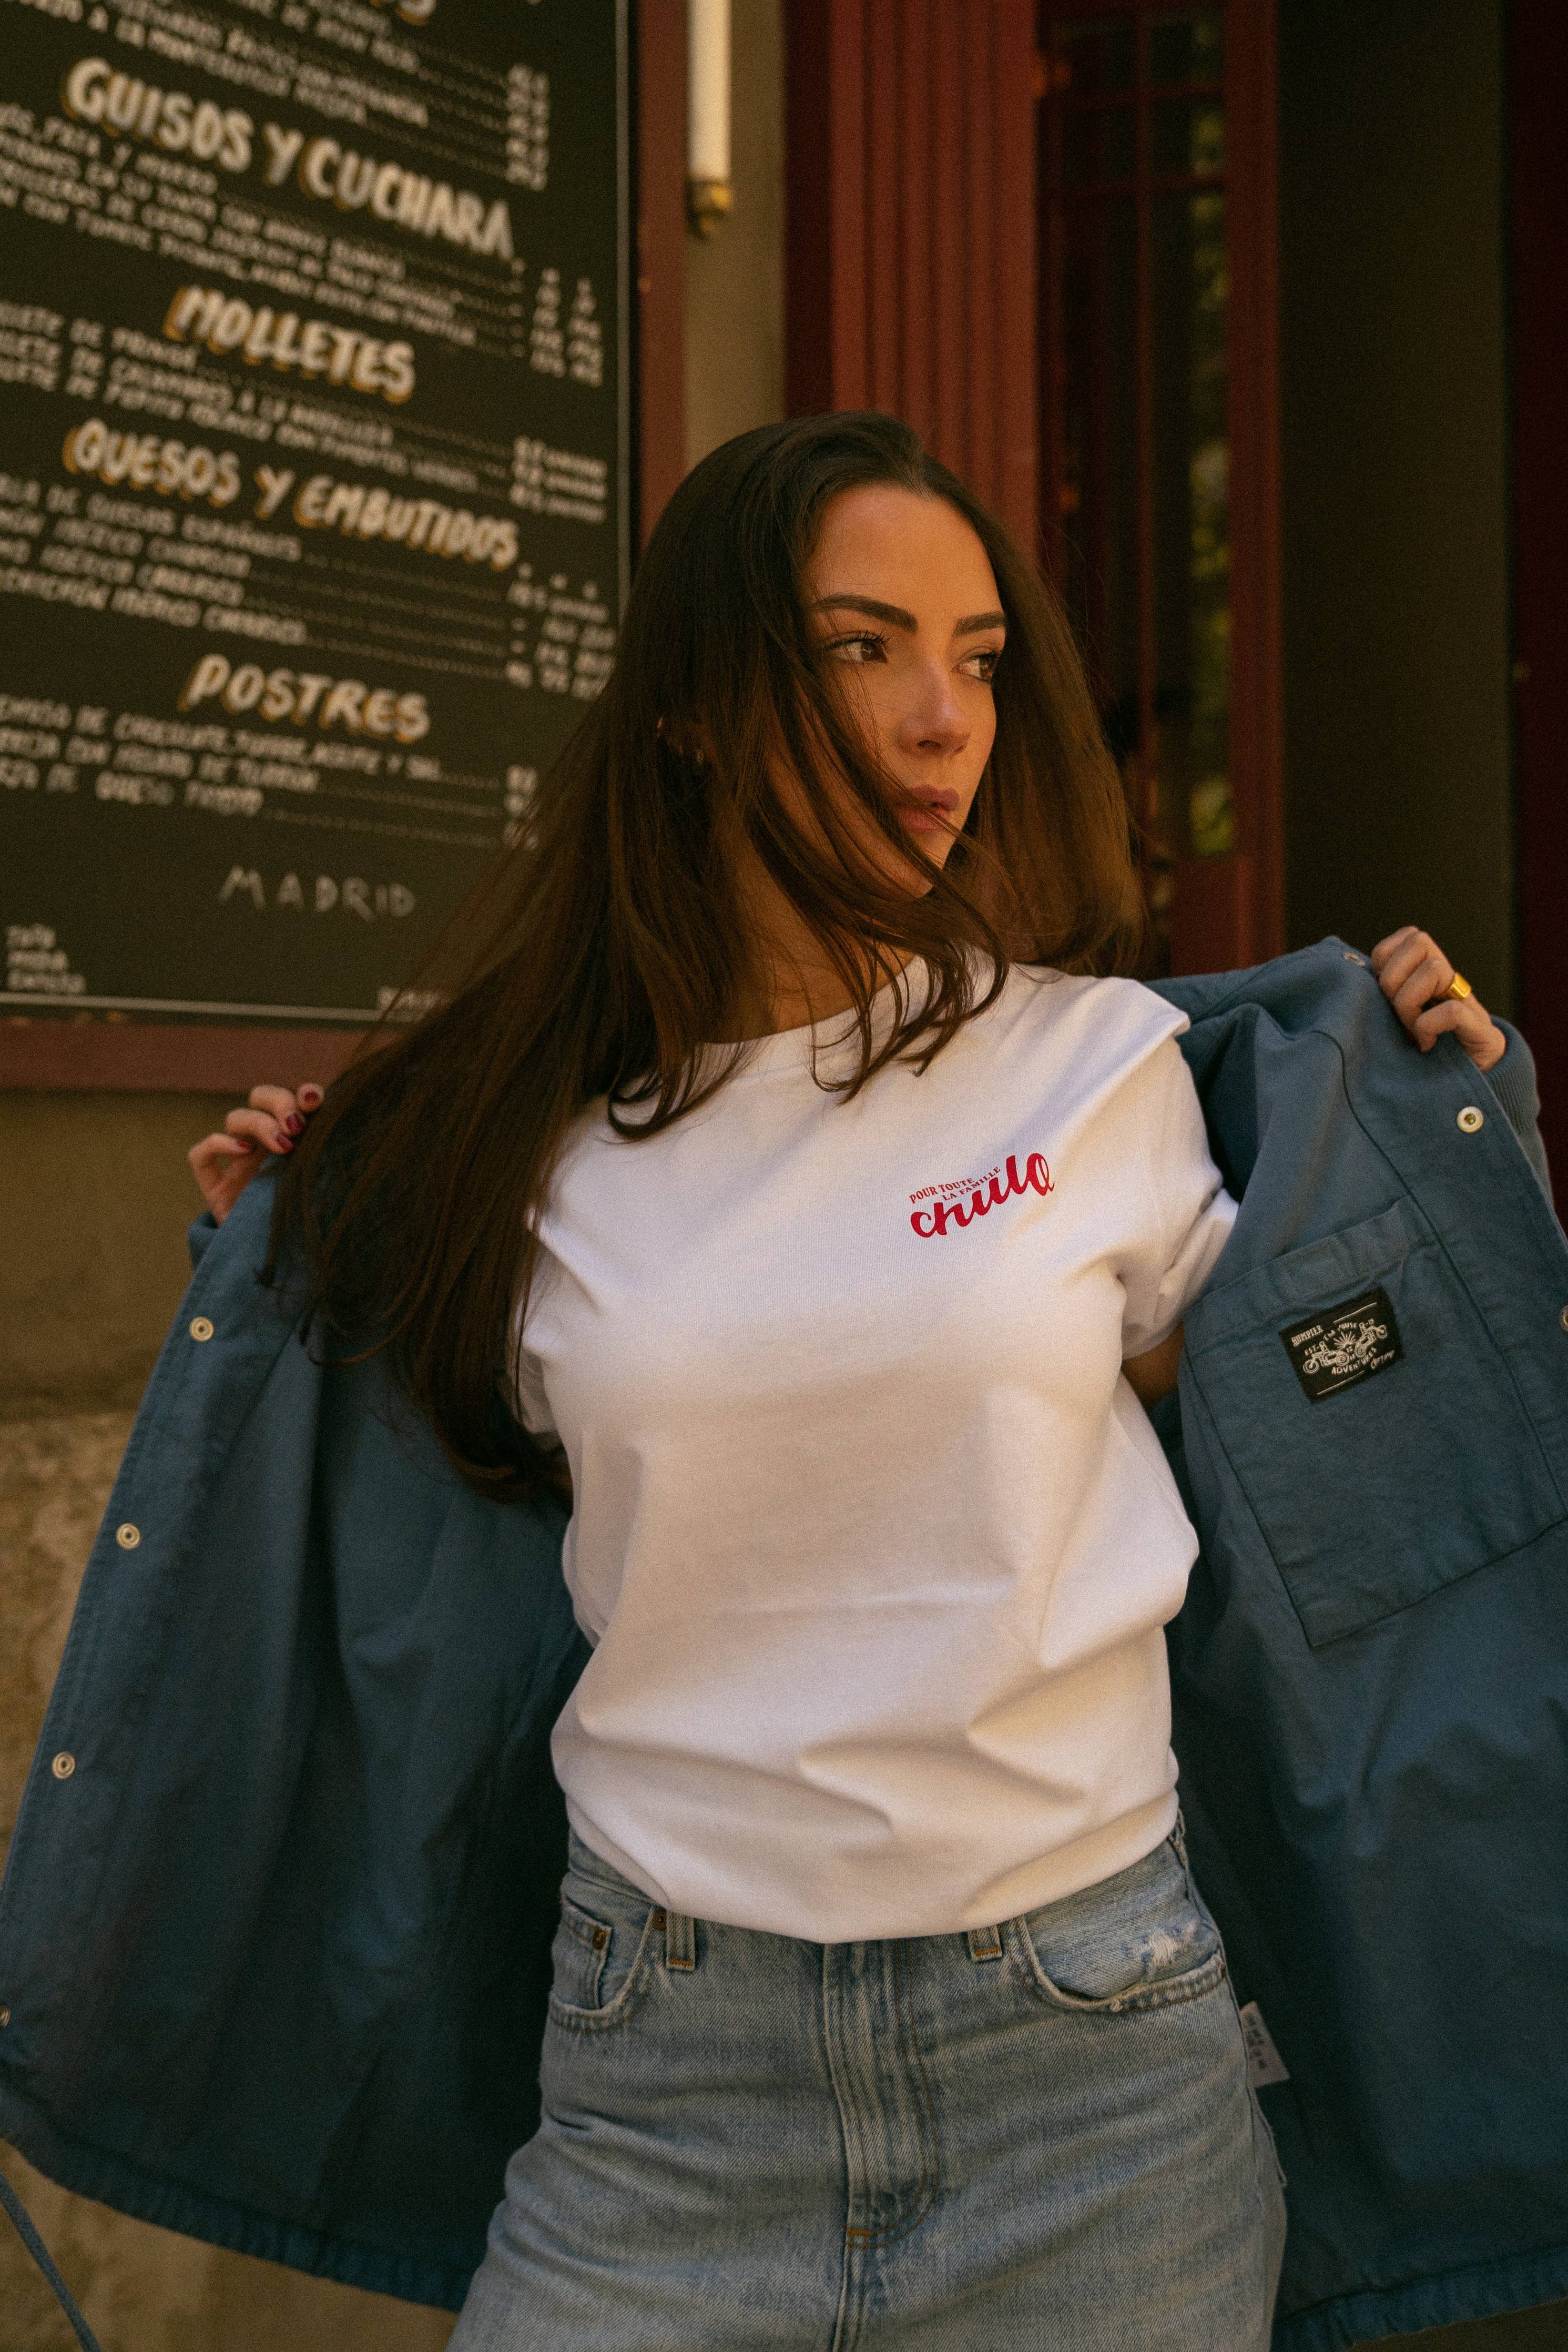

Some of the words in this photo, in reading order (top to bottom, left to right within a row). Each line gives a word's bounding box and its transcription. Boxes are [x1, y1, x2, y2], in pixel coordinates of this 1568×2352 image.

[64, 57, 253, 173] GUISOS
[263, 122, 305, 185] Y
[302, 136, 515, 263] CUCHARA
[166, 284, 416, 404] MOLLETES
[64, 418, 241, 506] QUESOS
[255, 464, 296, 520] Y
[294, 473, 520, 572] EMBUTIDOS
[180, 652, 431, 743] POSTRES
[218, 865, 416, 923] MADRID
[909, 1186, 939, 1204] POUR
[938, 1178, 974, 1193] TOUTE
[959, 1166, 1001, 1195] FAMILLE
[1330, 1346, 1378, 1375] ADVENTURES
